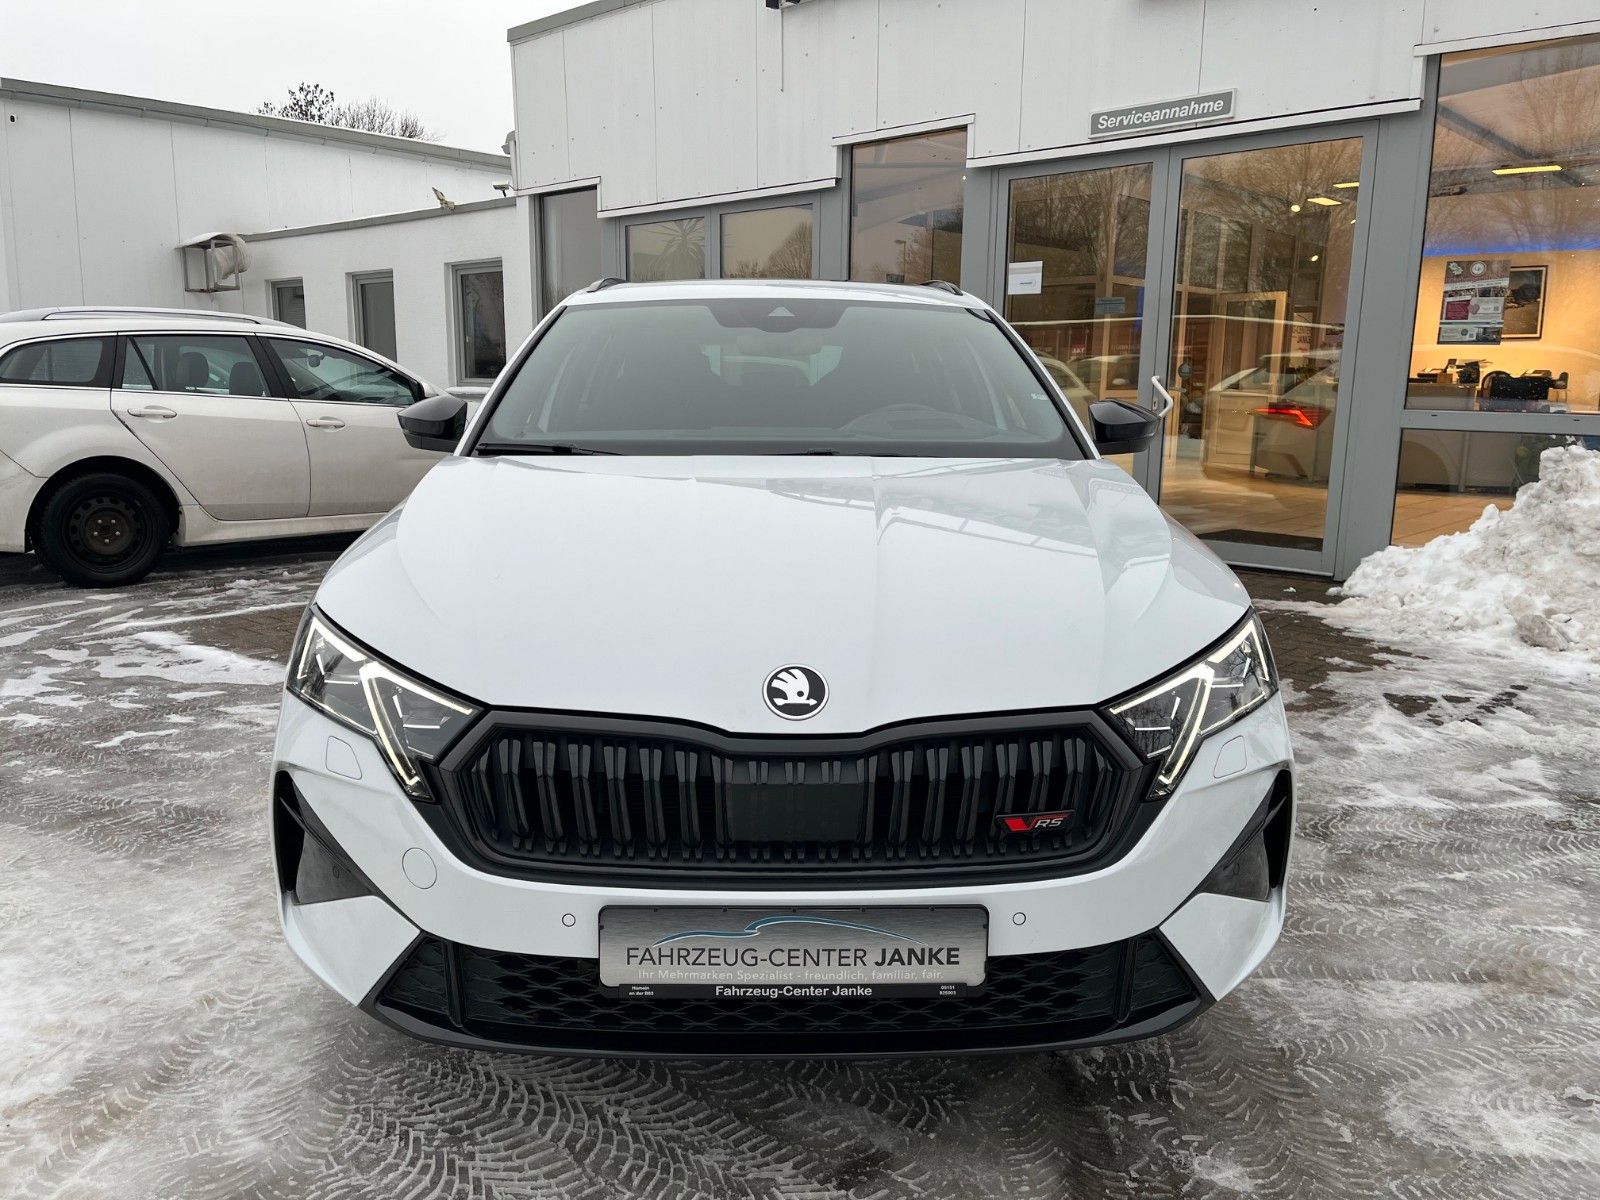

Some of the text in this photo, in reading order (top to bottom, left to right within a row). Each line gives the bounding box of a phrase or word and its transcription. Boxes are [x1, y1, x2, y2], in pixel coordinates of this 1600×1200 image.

[1097, 99, 1224, 129] Serviceannahme
[626, 947, 960, 967] FAHRZEUG-CENTER JANKE
[638, 970, 654, 979] Ihr
[658, 970, 733, 980] Mehrmarken
[737, 970, 793, 982] Spezialist
[805, 970, 868, 982] freundlich,
[872, 970, 918, 981] familiär,
[922, 970, 944, 980] fair.
[715, 985, 873, 998] Fahrzeug-Center Janke
